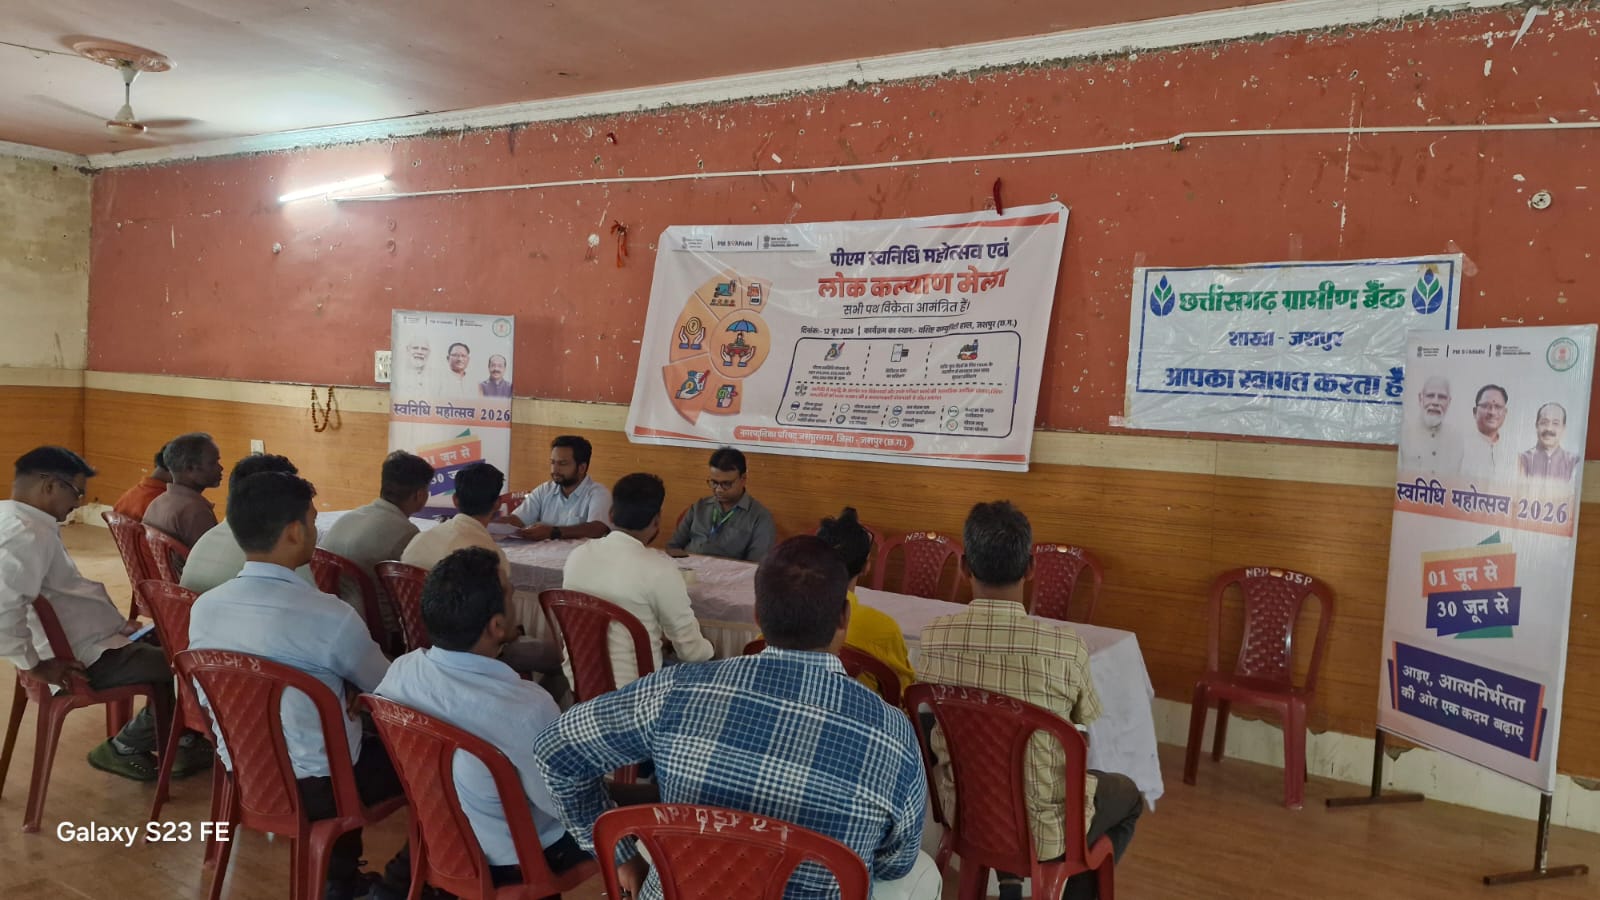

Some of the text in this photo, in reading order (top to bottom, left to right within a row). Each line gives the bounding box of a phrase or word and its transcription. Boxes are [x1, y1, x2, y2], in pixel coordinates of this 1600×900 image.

[830, 236, 1010, 266] पीएम स्वनिधि महोत्सव एवं
[818, 266, 1008, 298] लोक कल्याण मेला
[1179, 280, 1406, 314] छत्तीसगढ़ ग्रामीण बैंक
[843, 302, 864, 315] सभी
[866, 304, 880, 314] पथ
[880, 300, 914, 314] विक्रेता
[916, 298, 958, 313] आमंत्रित
[1228, 331, 1275, 346] शाखा
[1288, 331, 1344, 352] जशपुर
[1165, 368, 1236, 388] आपका
[1238, 369, 1311, 392] स्वागत
[1313, 372, 1382, 395] करता
[394, 400, 512, 421] स्वनिधि महोत्सव 2026
[1397, 478, 1568, 524] स्वनिधि महोत्सव 2026
[1285, 571, 1312, 586] JSP
[1428, 560, 1498, 590] 01 जून से
[1436, 592, 1510, 624] 30 जून से
[1402, 665, 1527, 714] आइए, आत्मनिर्भरता
[1400, 684, 1416, 701] की
[1418, 690, 1438, 710] ओर
[1441, 699, 1461, 716] एक
[1462, 706, 1490, 726] कदम
